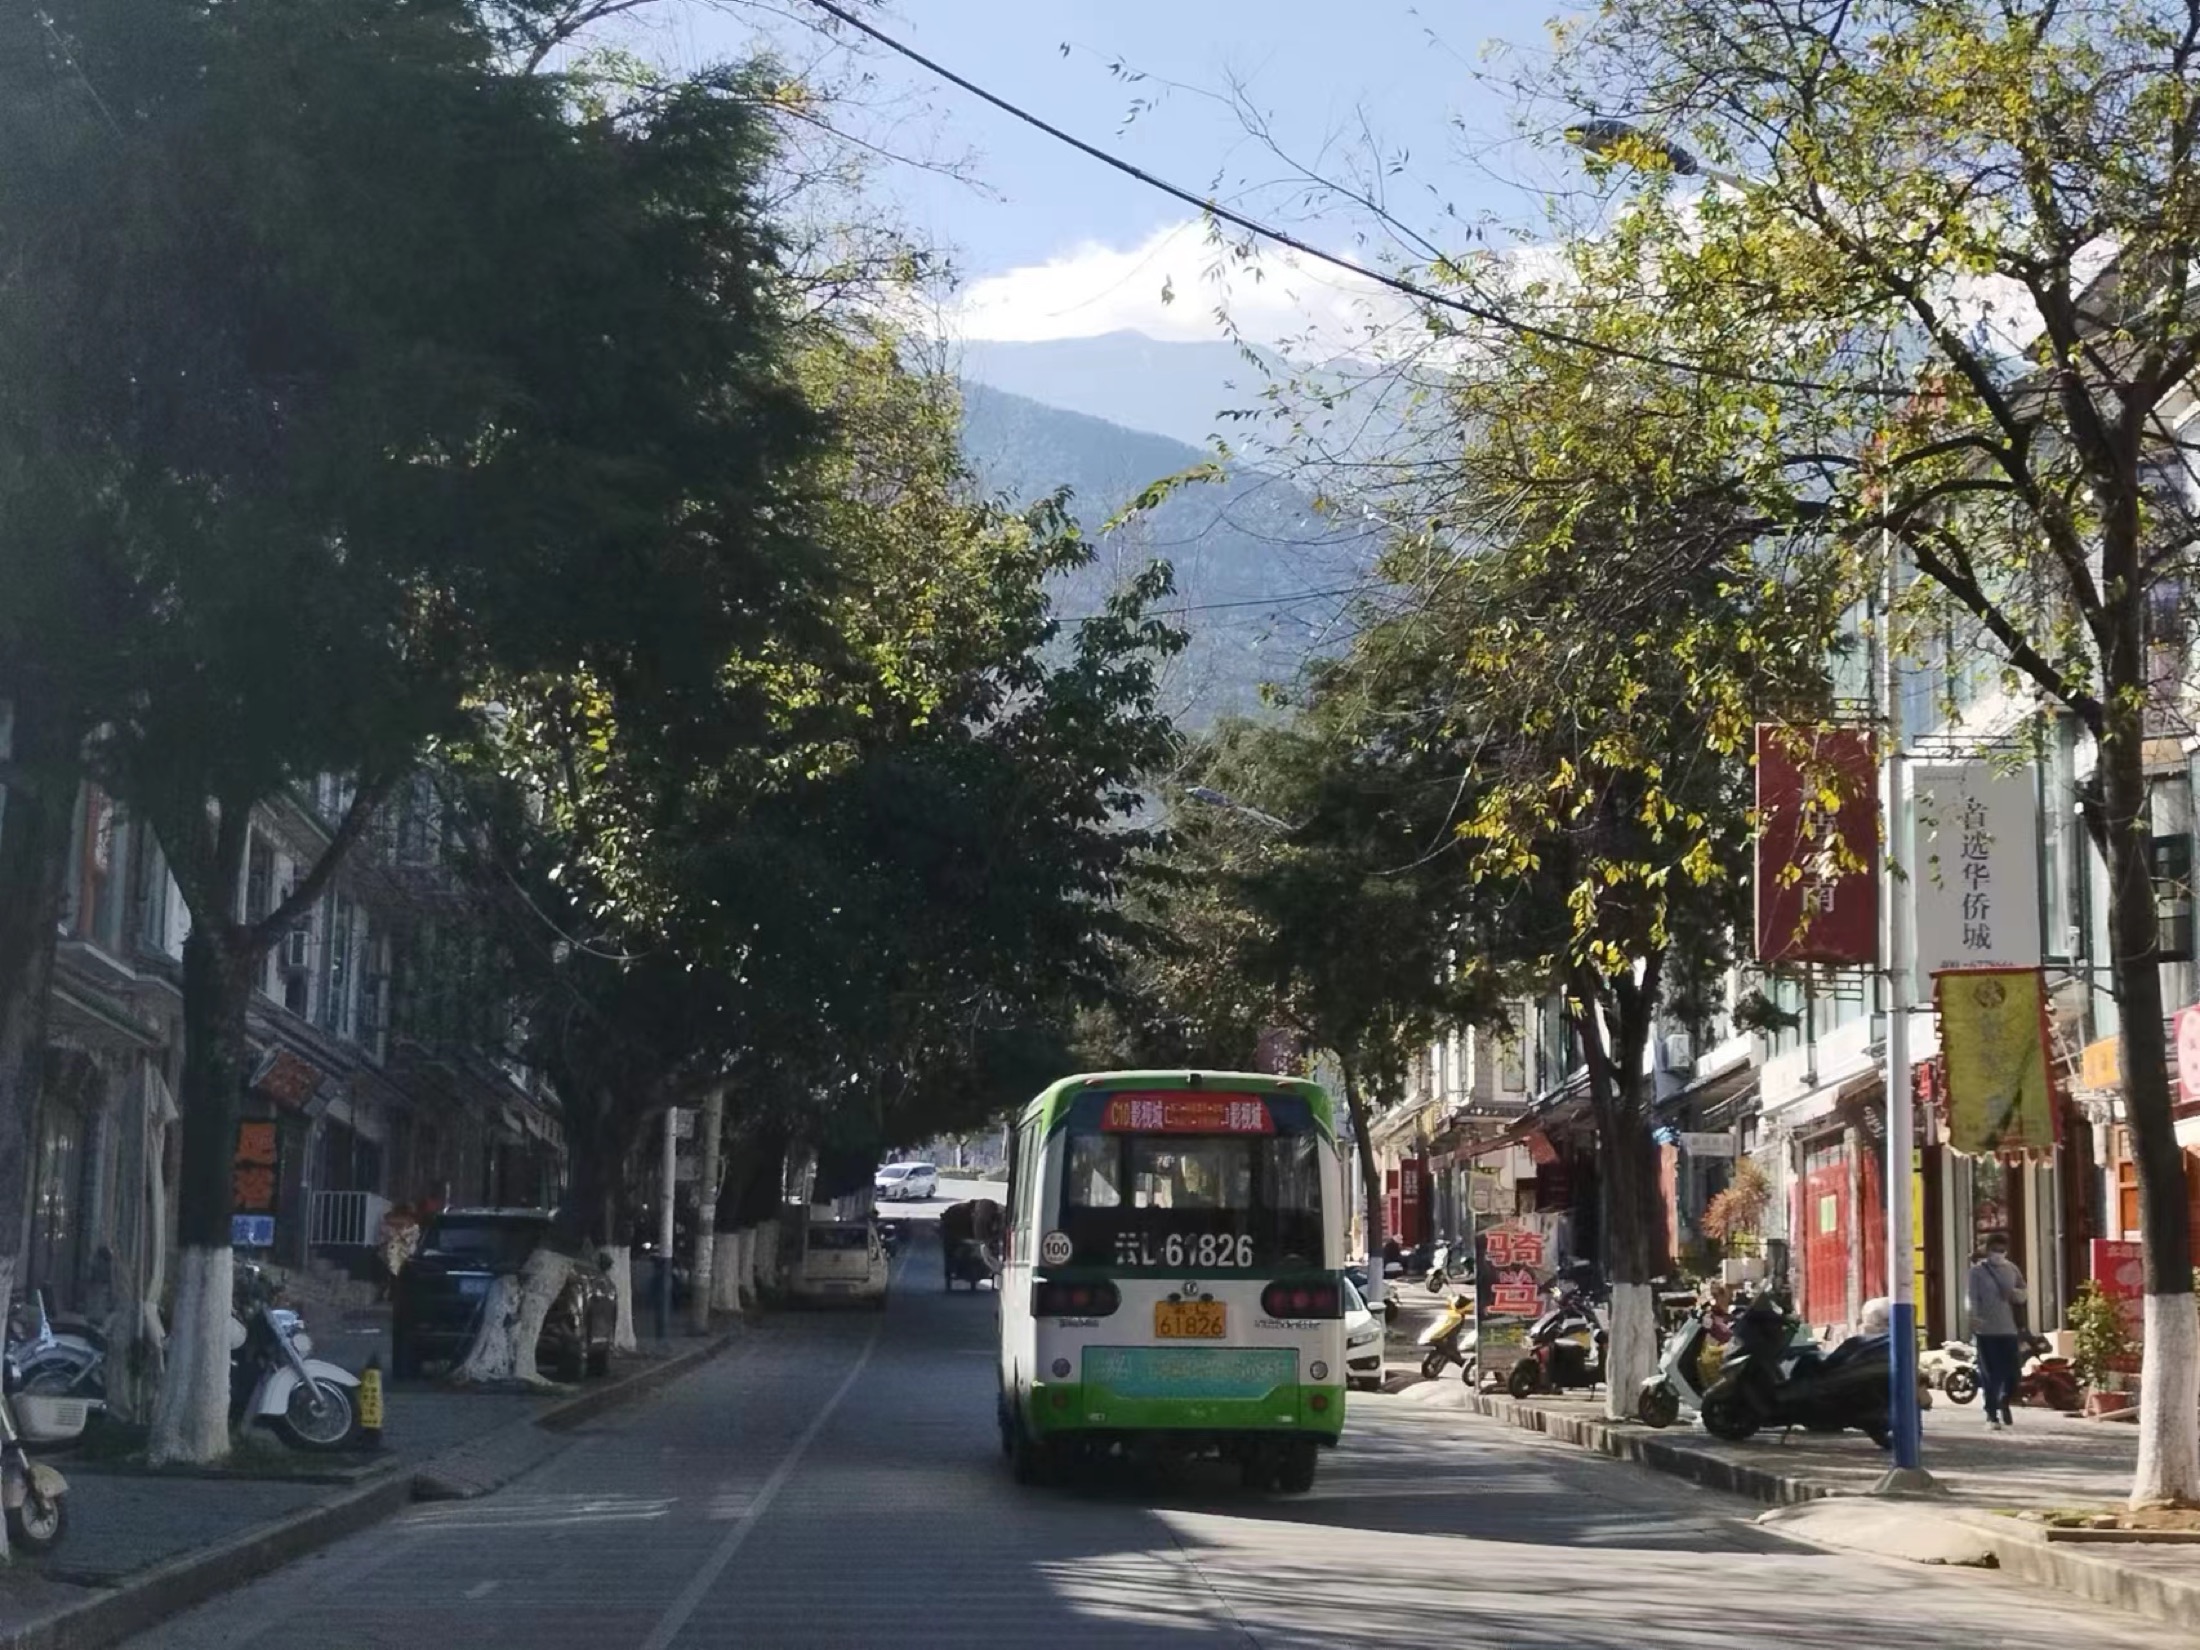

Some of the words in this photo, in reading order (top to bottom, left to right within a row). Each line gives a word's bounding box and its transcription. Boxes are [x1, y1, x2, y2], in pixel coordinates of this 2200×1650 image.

[1960, 796, 1993, 951] 首选华侨城
[1045, 1242, 1069, 1256] 100
[1160, 1316, 1223, 1335] 61826
